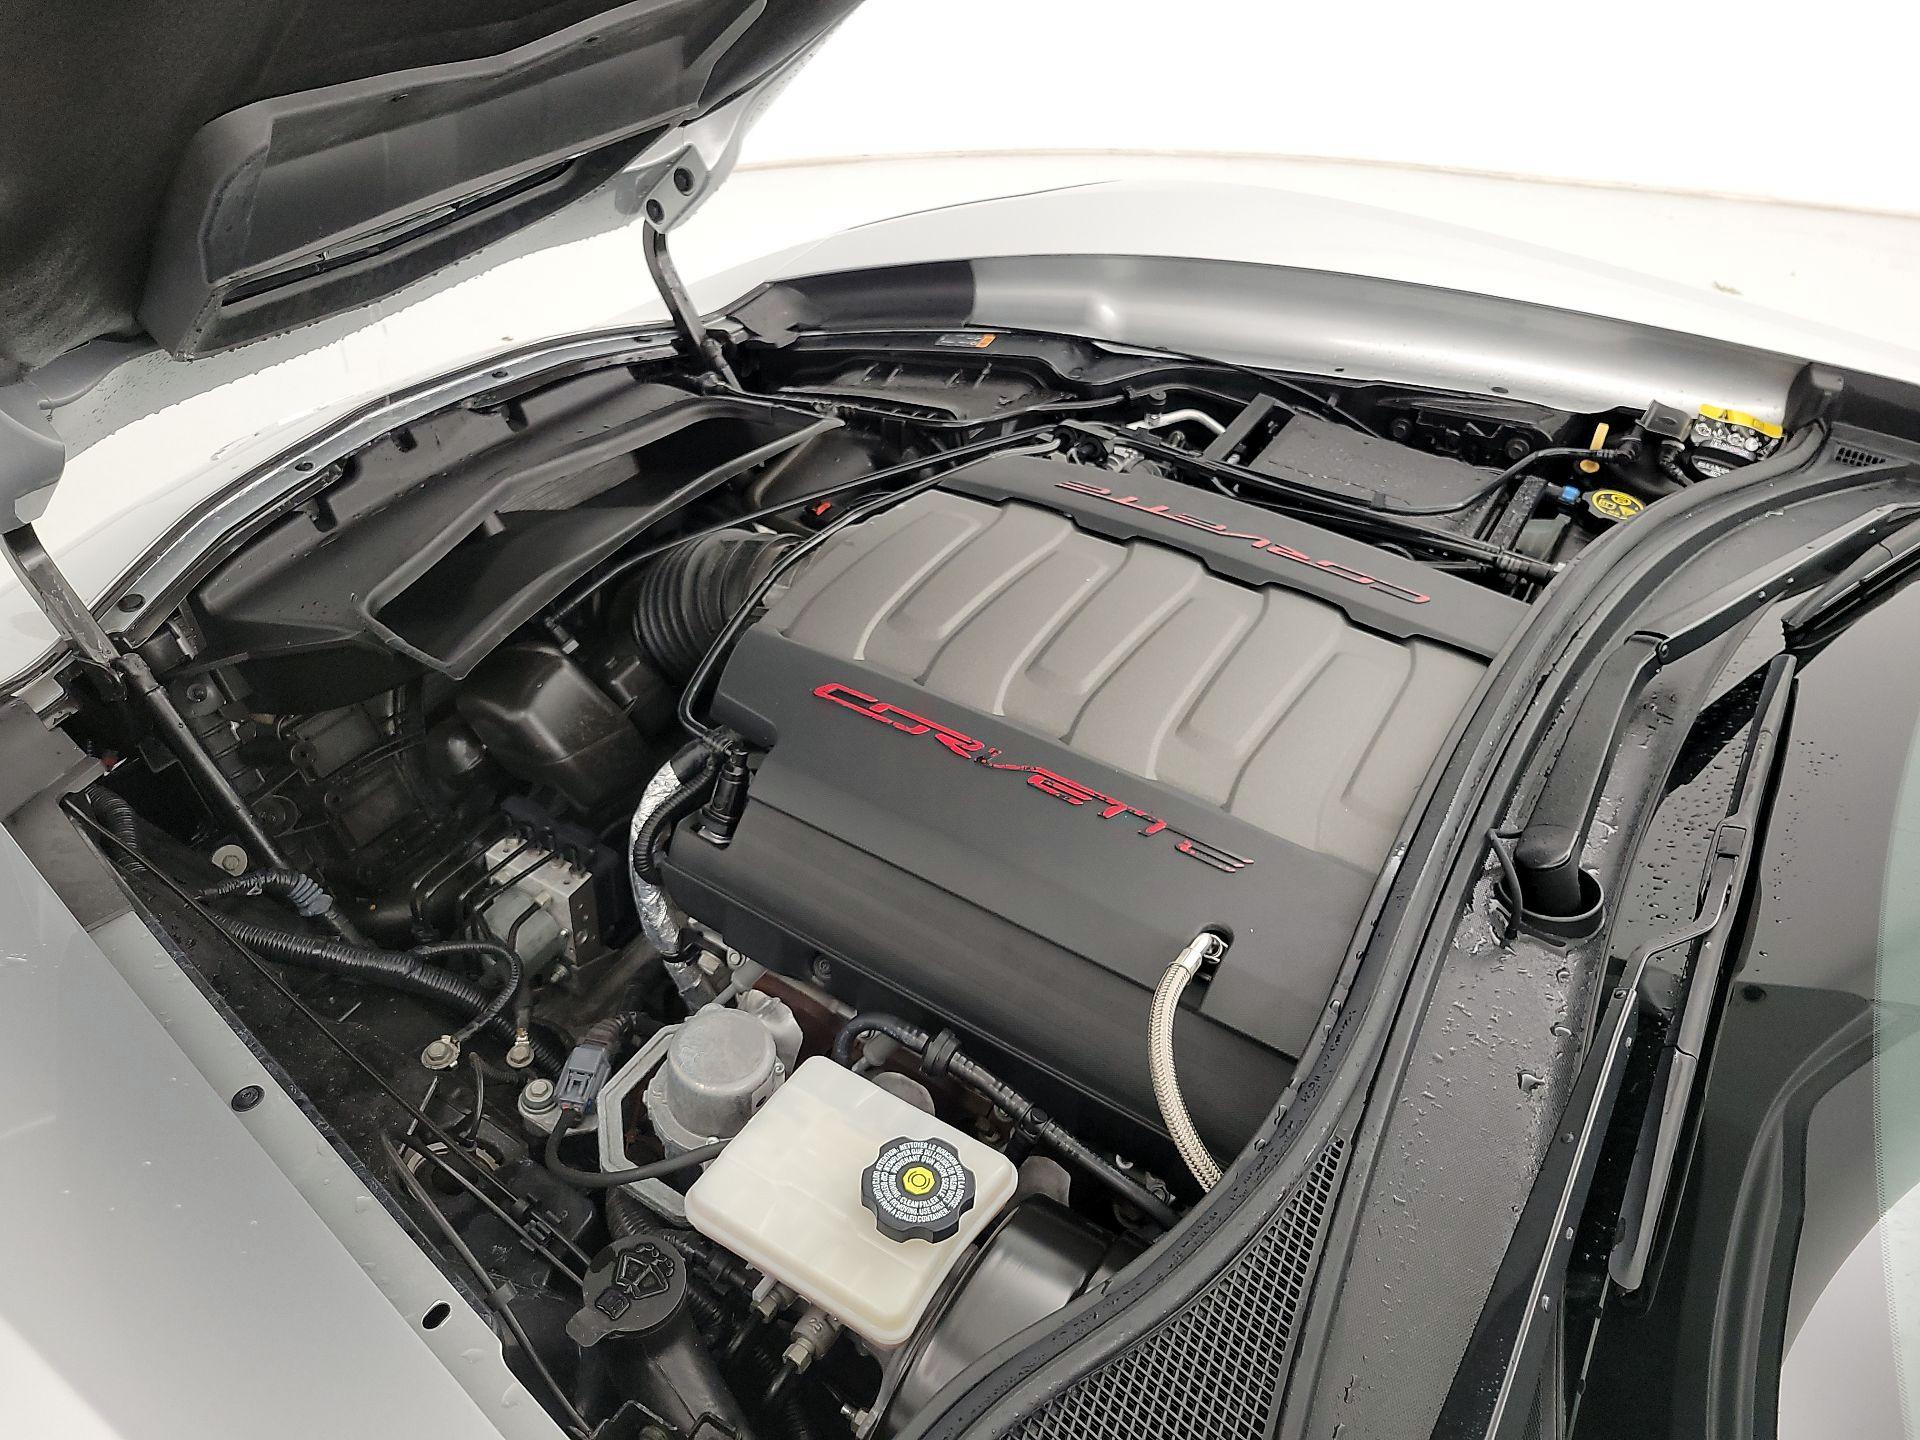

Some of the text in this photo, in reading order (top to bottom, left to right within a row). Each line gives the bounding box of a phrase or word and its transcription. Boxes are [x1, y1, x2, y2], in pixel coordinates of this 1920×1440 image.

[1055, 481, 1430, 604] CORVETTE
[811, 682, 1254, 873] CORVETTE
[879, 1198, 893, 1212] FROM
[895, 1211, 917, 1222] SEALED
[918, 1208, 951, 1222] CONTAINER.
[900, 1197, 918, 1208] CLEAN
[920, 1196, 939, 1208] FILLER
[919, 1207, 931, 1215] USE
[931, 1201, 945, 1212] ONLY
